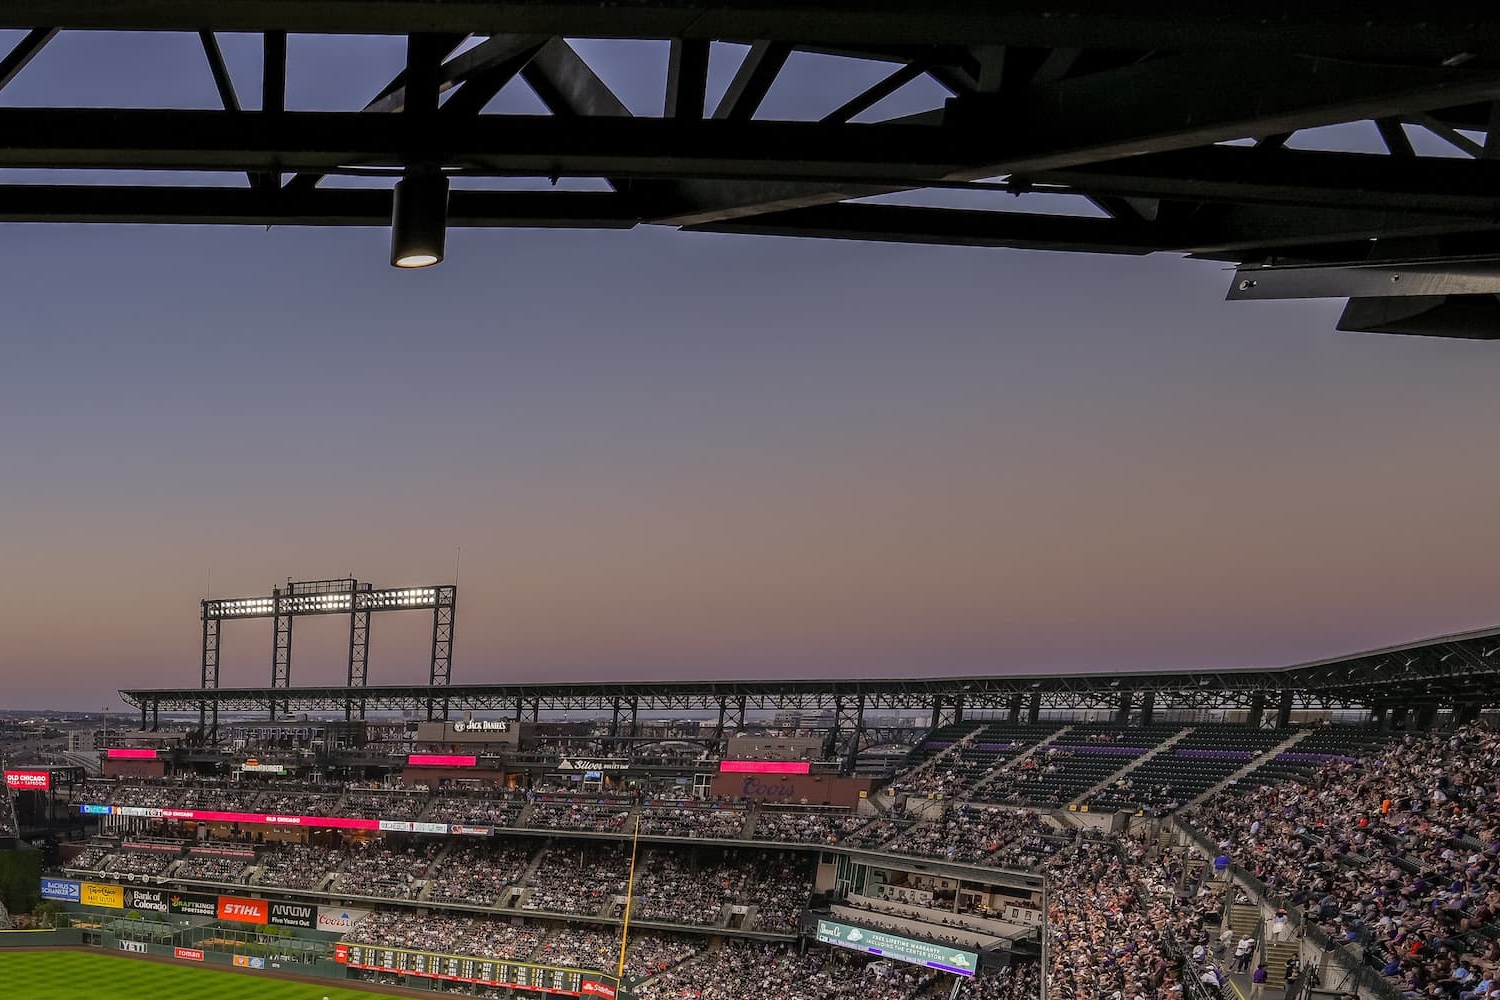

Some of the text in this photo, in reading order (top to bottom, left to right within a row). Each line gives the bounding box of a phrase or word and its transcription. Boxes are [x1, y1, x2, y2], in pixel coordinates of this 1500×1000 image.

[466, 719, 507, 730] JACK DANIEL'S
[743, 776, 795, 799] Coors
[133, 891, 161, 901] Bank of
[133, 899, 168, 912] Colorado
[172, 900, 215, 910] DRAFTKINGS
[181, 906, 215, 915] SPORTSBOOK
[223, 903, 261, 917] STIHL
[283, 918, 299, 926] Years
[299, 919, 310, 927] Out
[318, 914, 345, 926] Coors
[122, 941, 146, 952] YETI
[866, 938, 894, 949] INCLUDING
[905, 948, 926, 957] CENTER
[886, 937, 909, 947] LIFETIME
[178, 950, 201, 958] roman
